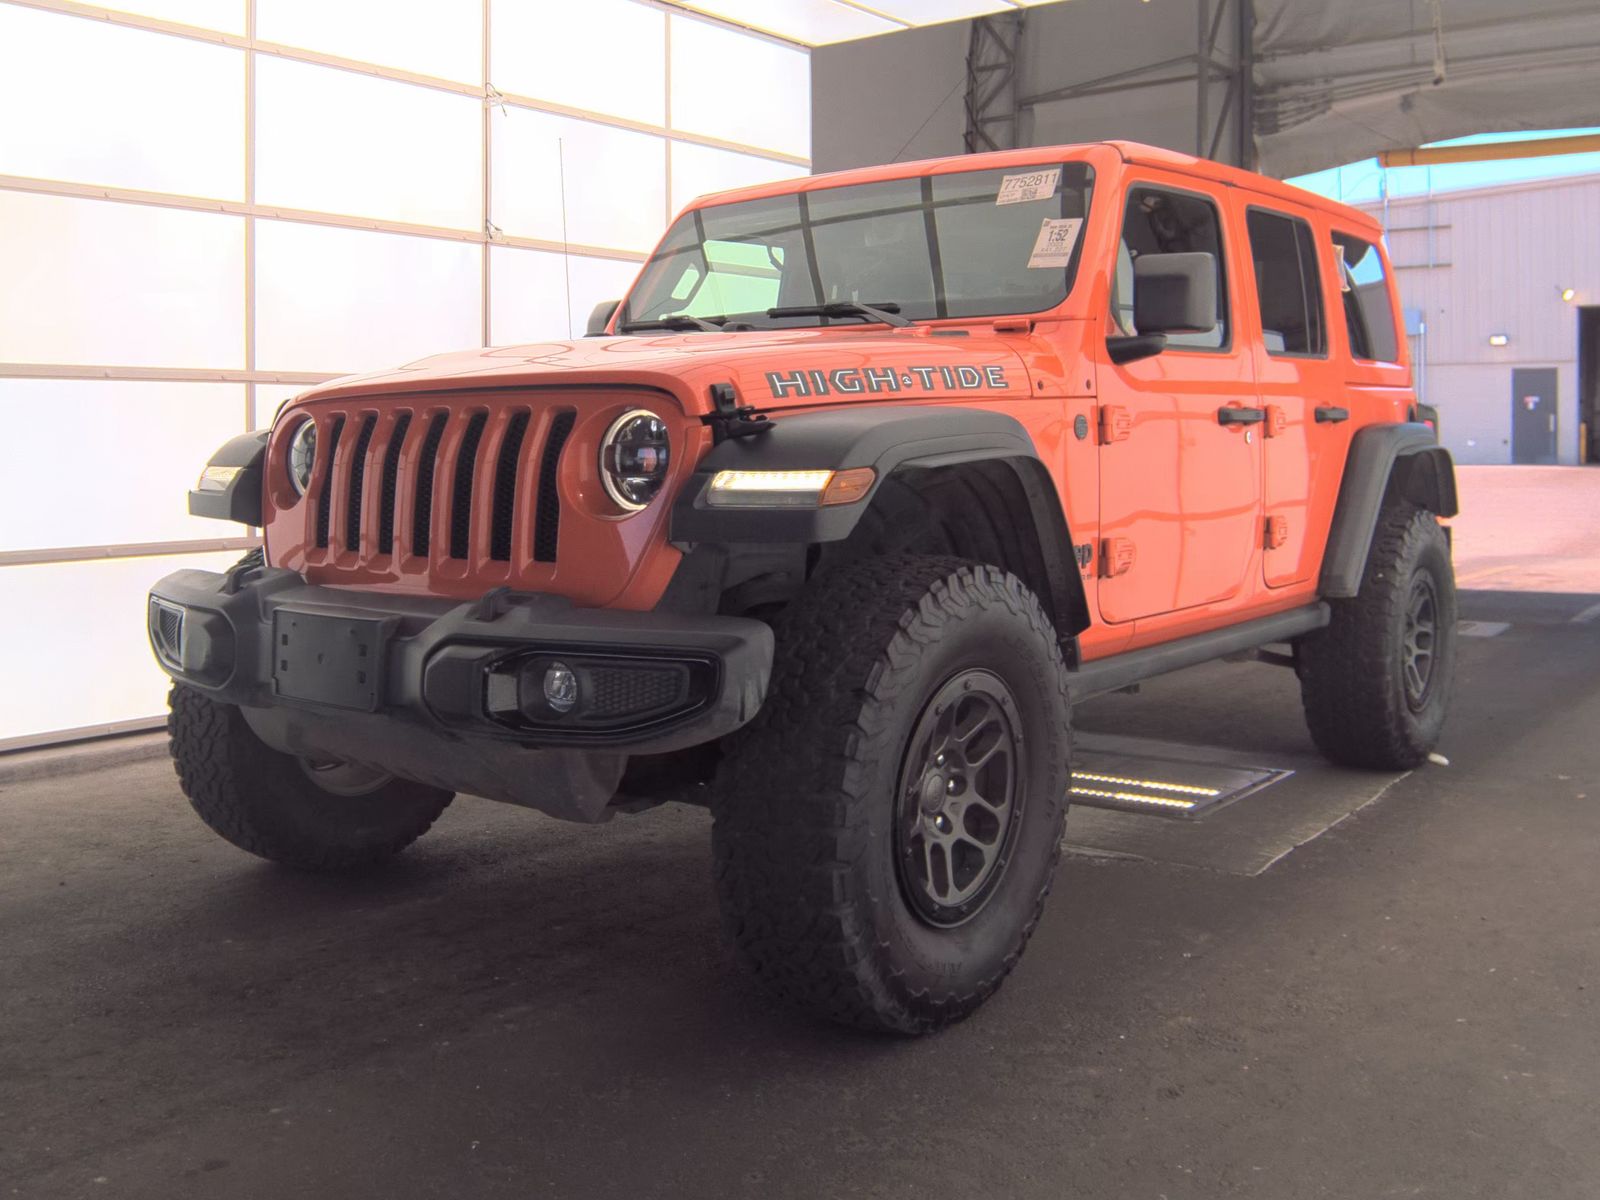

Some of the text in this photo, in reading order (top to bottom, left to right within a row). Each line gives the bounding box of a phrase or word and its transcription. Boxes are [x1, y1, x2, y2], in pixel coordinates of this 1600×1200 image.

[1005, 173, 1057, 190] 7752811
[765, 365, 1009, 398] HIGH TIDE
